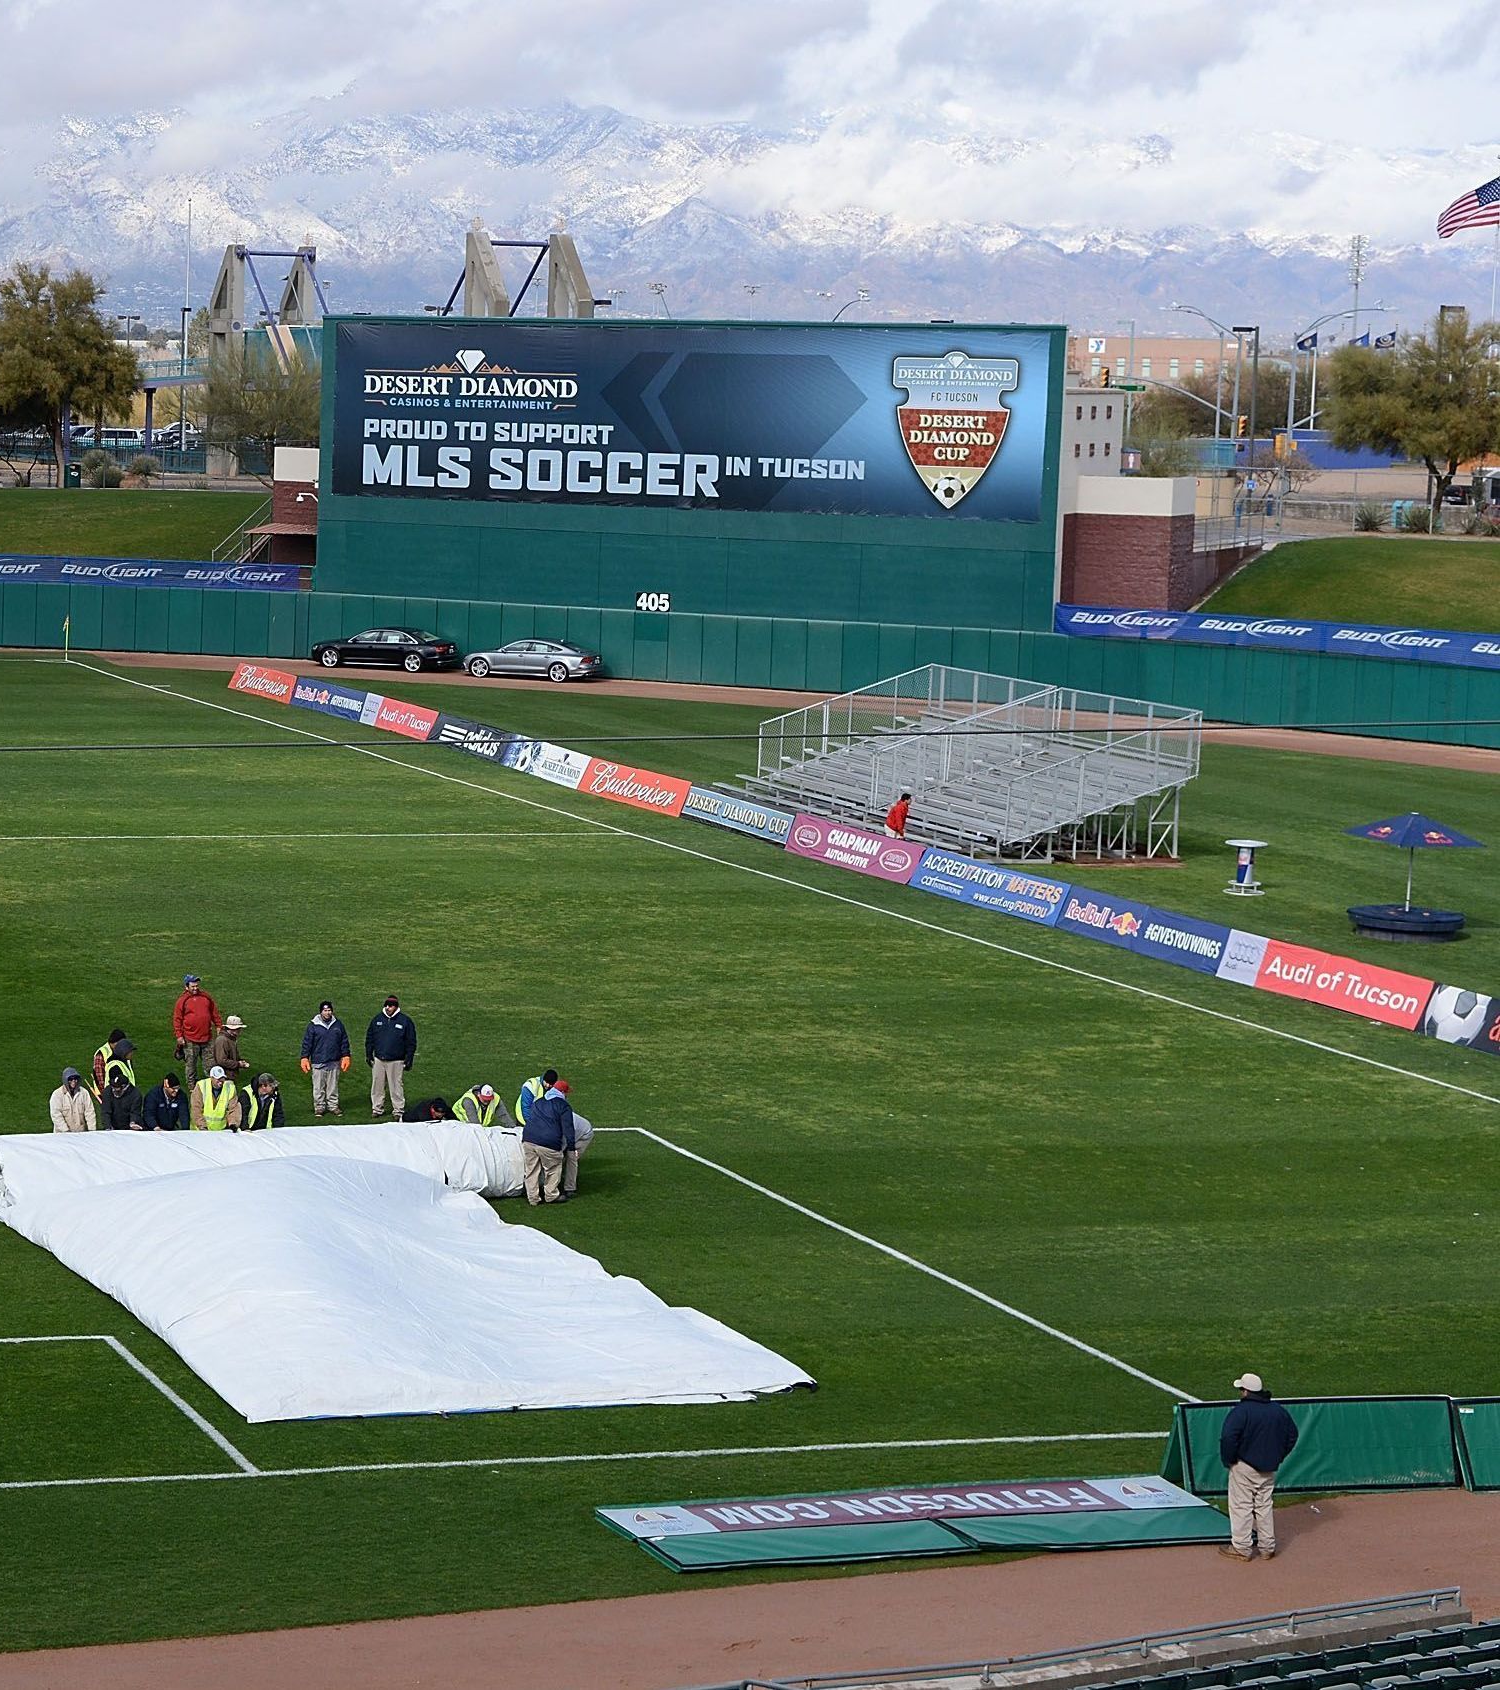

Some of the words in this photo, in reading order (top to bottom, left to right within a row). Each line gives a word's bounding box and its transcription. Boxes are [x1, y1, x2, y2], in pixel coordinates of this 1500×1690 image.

[898, 369, 947, 380] DESERT
[950, 370, 1012, 381] DIAMOND
[364, 375, 453, 396] DESERT
[460, 377, 578, 398] DIAMOND
[390, 398, 440, 408] CASINOS
[444, 399, 451, 408] &
[455, 399, 552, 410] ENTERTAINMENT
[931, 392, 942, 401] FC
[946, 393, 978, 402] TUCSON
[364, 418, 448, 440] PROUD
[454, 421, 487, 442] TO
[494, 422, 614, 444] SUPPORT
[919, 414, 987, 429] DESERT
[909, 430, 995, 446] DIAMOND
[933, 447, 970, 460] CUP
[362, 444, 471, 489] MLS
[489, 448, 720, 498] SOCCER
[726, 456, 750, 476] IN
[758, 458, 865, 480] TUCSON
[61, 564, 101, 576] BUD
[110, 568, 162, 577] LIGHT
[184, 568, 225, 580] BUD
[234, 572, 286, 582] LIGHT
[636, 592, 670, 612] 405
[1070, 612, 1116, 624] BUD
[1122, 615, 1178, 627] LIGHT
[1200, 619, 1246, 632] BUD
[1254, 623, 1312, 636] LIGHT
[1332, 630, 1380, 642] BUD
[1390, 636, 1450, 648] LIGHT
[1472, 642, 1500, 654] BU
[236, 666, 290, 696] Budweiser
[380, 706, 397, 722] Audi
[397, 713, 409, 724] of
[407, 714, 431, 732] Tucson
[590, 762, 676, 807] Budweiser
[686, 792, 722, 816] DESERT
[722, 803, 766, 830] DIAMOND
[769, 817, 788, 836] CUP
[828, 829, 882, 856] CHAPMAN
[824, 848, 870, 868] AUTOMOTIVE
[923, 854, 1006, 888] ACCREDITATION
[1005, 876, 1064, 904] MATTERS
[973, 892, 1048, 918] www.carf.org/FORYOU
[1144, 924, 1222, 959] #GIVESYOUWINGS
[1265, 956, 1316, 985] Audi
[1316, 972, 1344, 991] of
[1345, 974, 1419, 1014] Tucson
[705, 1487, 1106, 1525] FCTUCSON.COM
